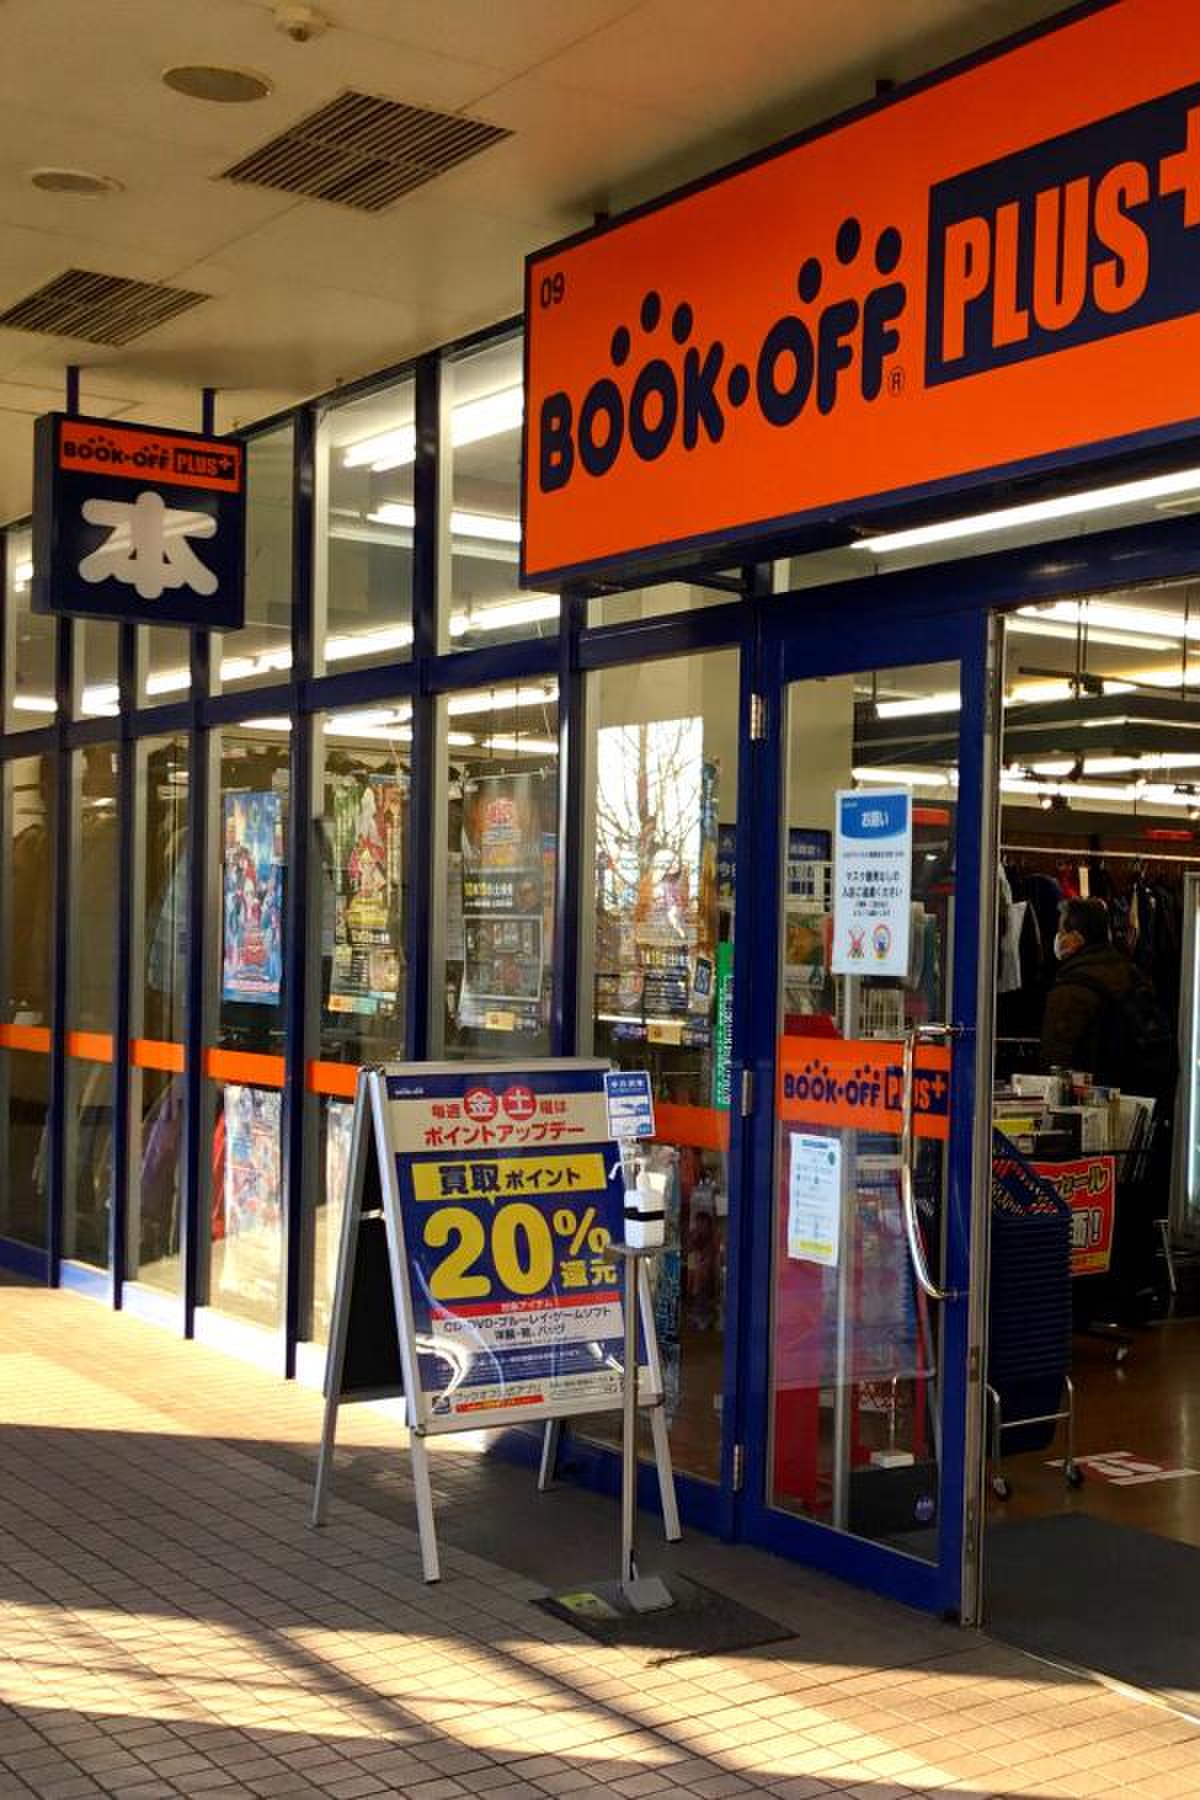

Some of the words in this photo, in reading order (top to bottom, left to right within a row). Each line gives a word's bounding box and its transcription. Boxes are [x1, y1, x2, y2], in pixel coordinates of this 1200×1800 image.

[540, 272, 565, 309] 09
[78, 491, 219, 600] 本
[423, 1124, 585, 1148] ポイントアップデー
[422, 1203, 612, 1299] 20%
